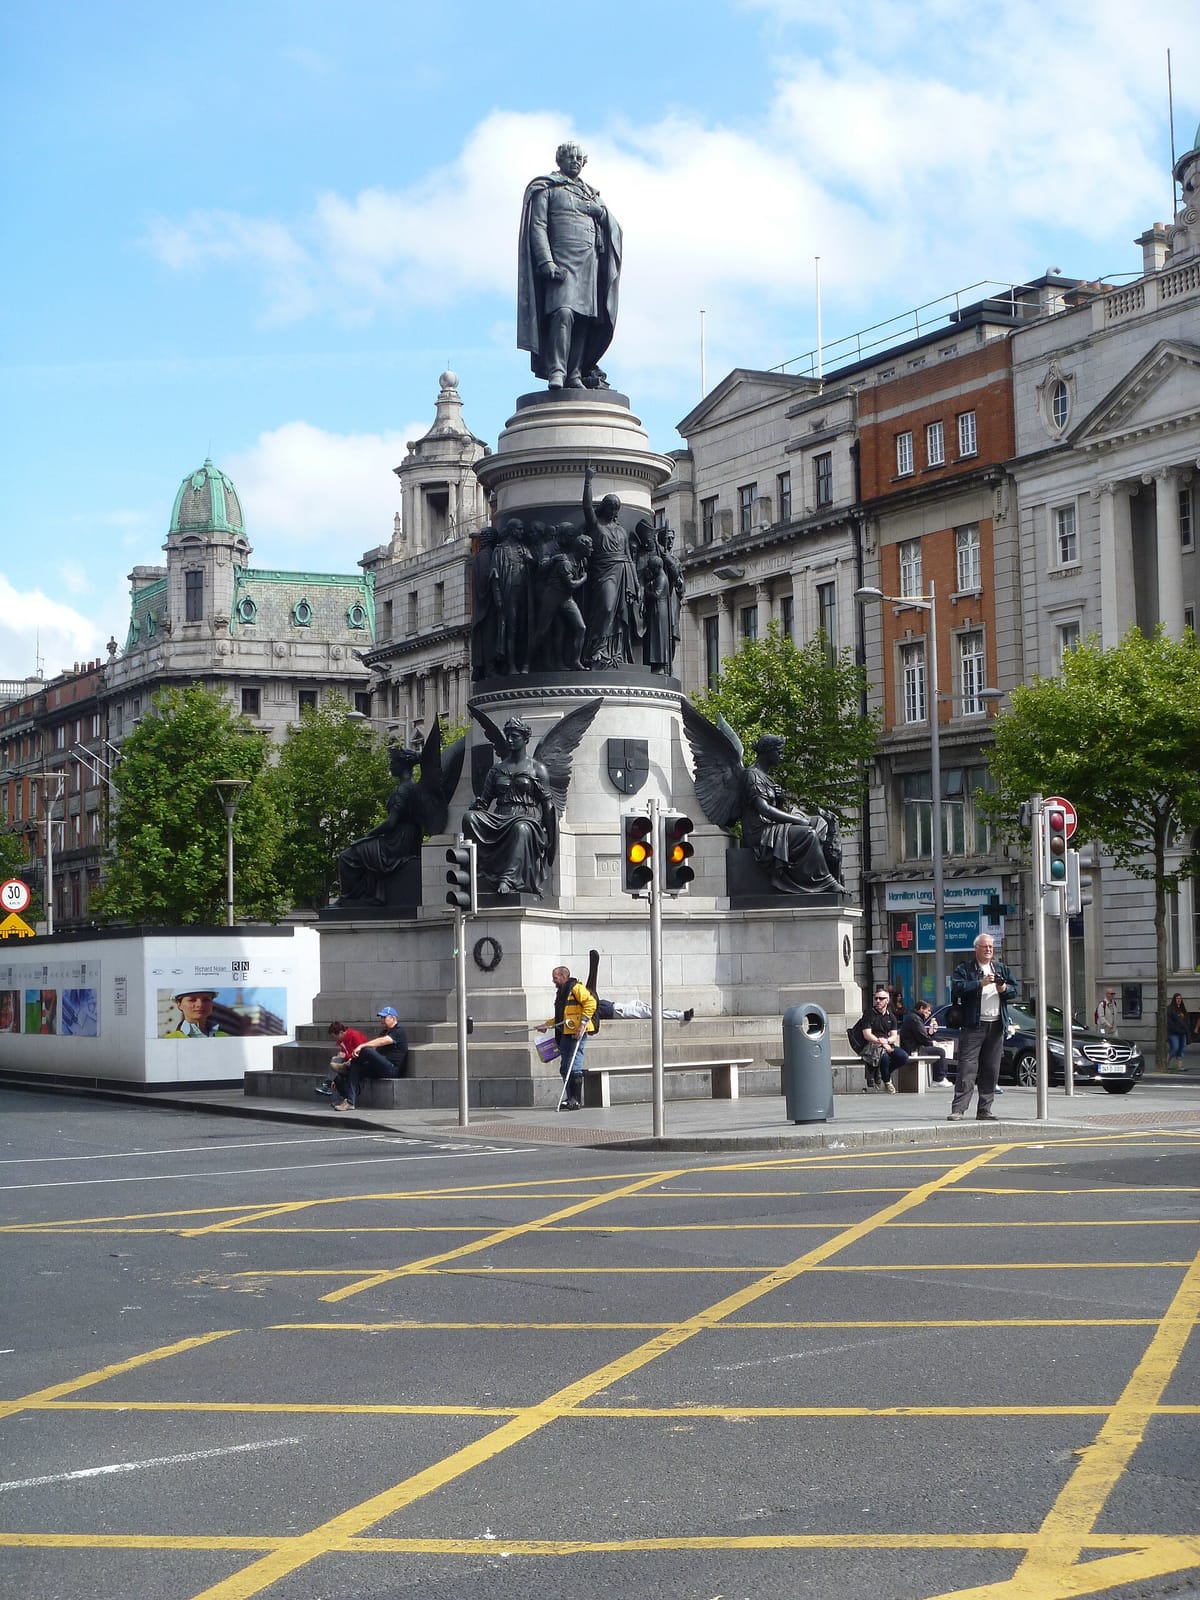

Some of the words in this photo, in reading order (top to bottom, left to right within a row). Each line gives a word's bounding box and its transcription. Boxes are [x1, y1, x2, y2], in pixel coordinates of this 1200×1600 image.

[7, 885, 20, 899] 30
[888, 891, 915, 901] Hamilton
[916, 890, 932, 901] Long
[963, 887, 997, 897] Pharmacy
[919, 922, 933, 931] Late
[948, 921, 977, 930] Pharmacy
